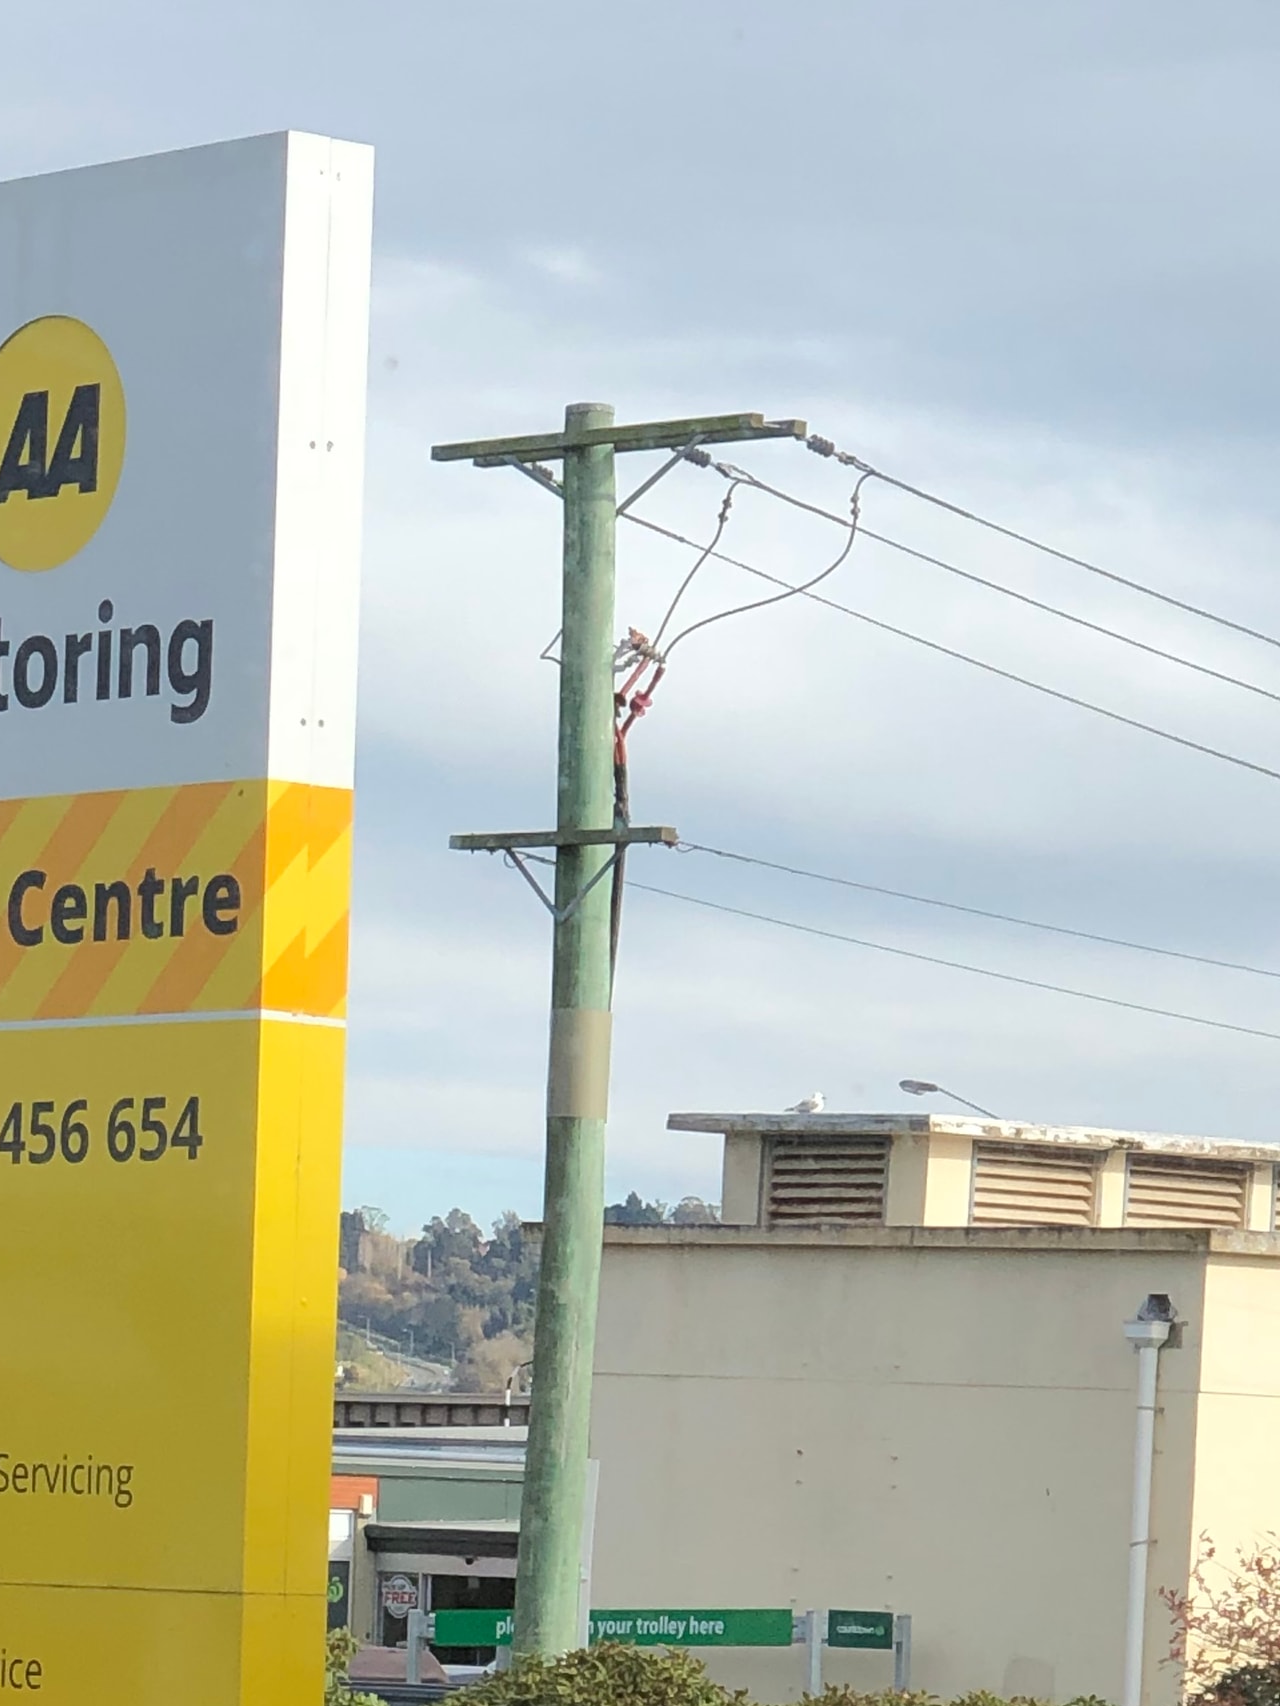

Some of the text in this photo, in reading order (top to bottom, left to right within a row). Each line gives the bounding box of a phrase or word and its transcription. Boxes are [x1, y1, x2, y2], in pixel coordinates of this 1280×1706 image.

[7, 868, 241, 947] Centre
[106, 1096, 204, 1163] 654
[384, 1591, 416, 1604] FREE
[597, 1619, 632, 1638] your
[636, 1616, 685, 1638] trolley
[689, 1616, 725, 1635] here
